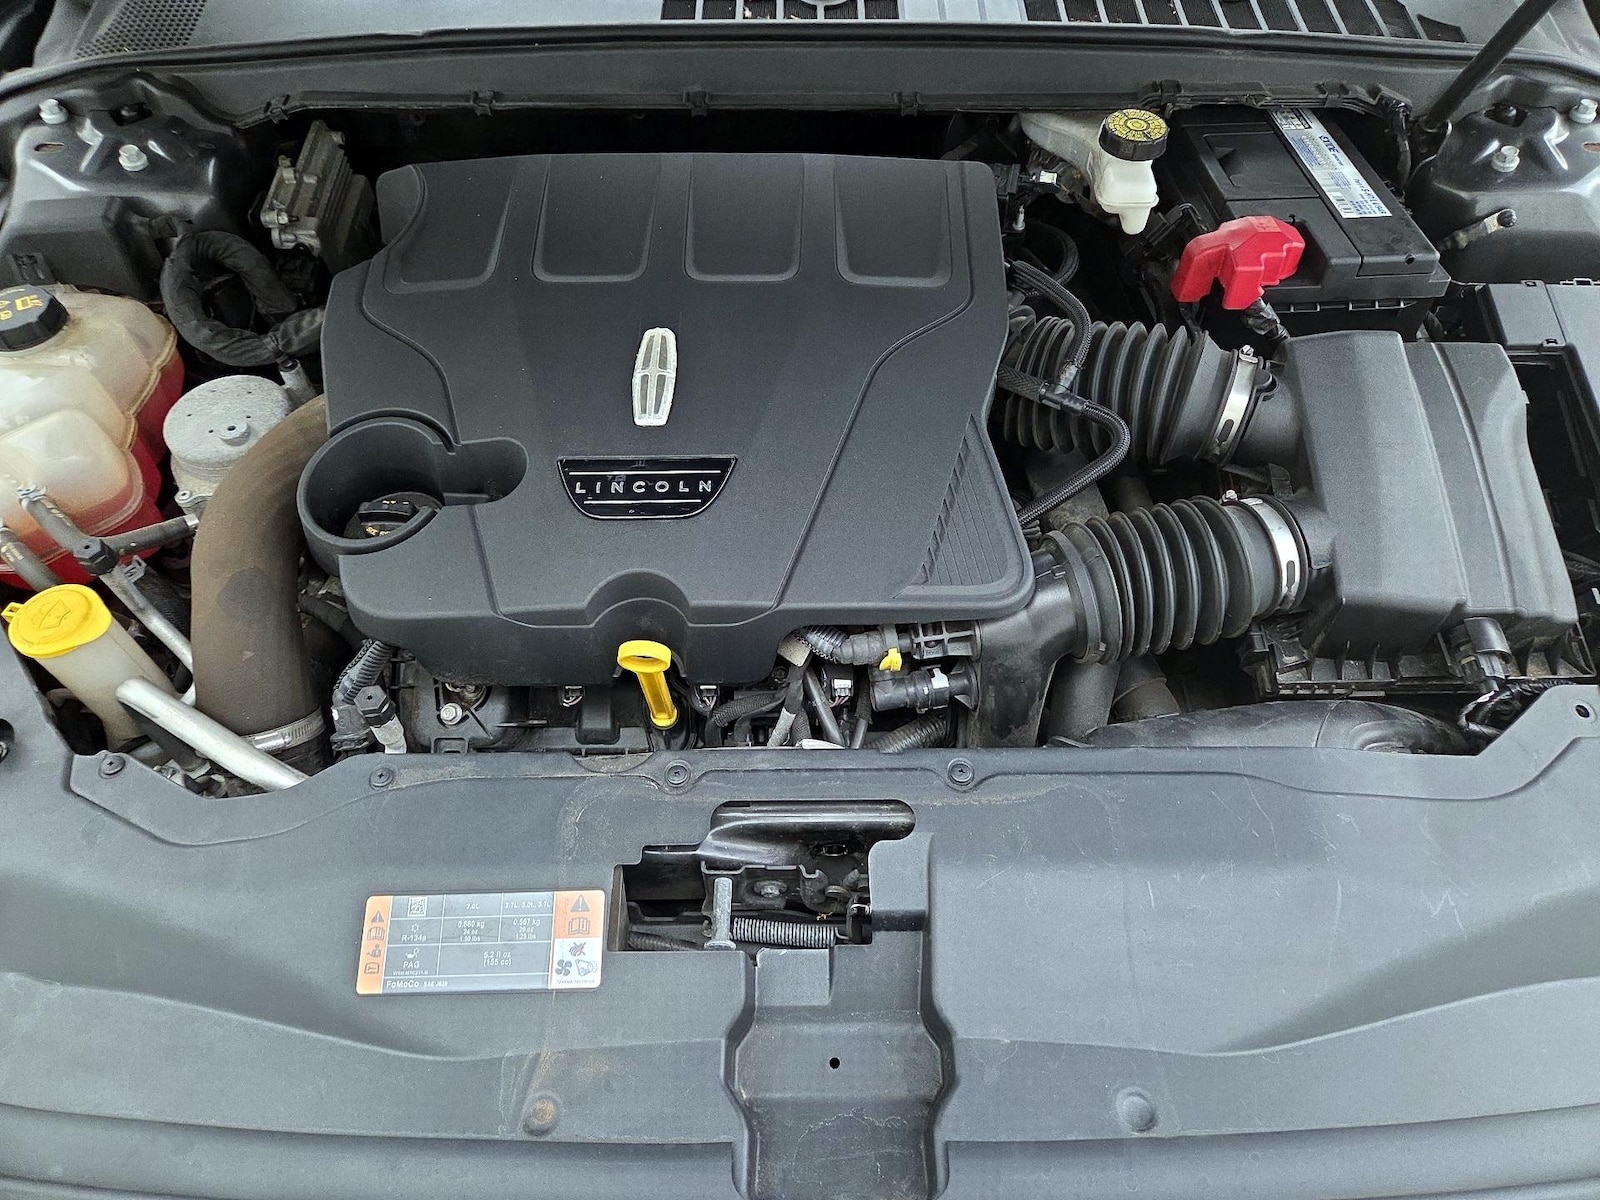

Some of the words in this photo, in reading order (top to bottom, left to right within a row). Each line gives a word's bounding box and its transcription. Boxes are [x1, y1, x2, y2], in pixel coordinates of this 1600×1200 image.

[575, 480, 712, 494] LINCOLN
[466, 902, 480, 910] 2.0L
[476, 920, 485, 929] kg
[532, 918, 541, 926] kg
[401, 934, 427, 942] R-134a
[483, 951, 495, 959] 5.2
[403, 961, 420, 969] PAG
[483, 959, 499, 967] (155
[500, 958, 512, 966] cc)
[386, 980, 419, 989] FoMoCo
